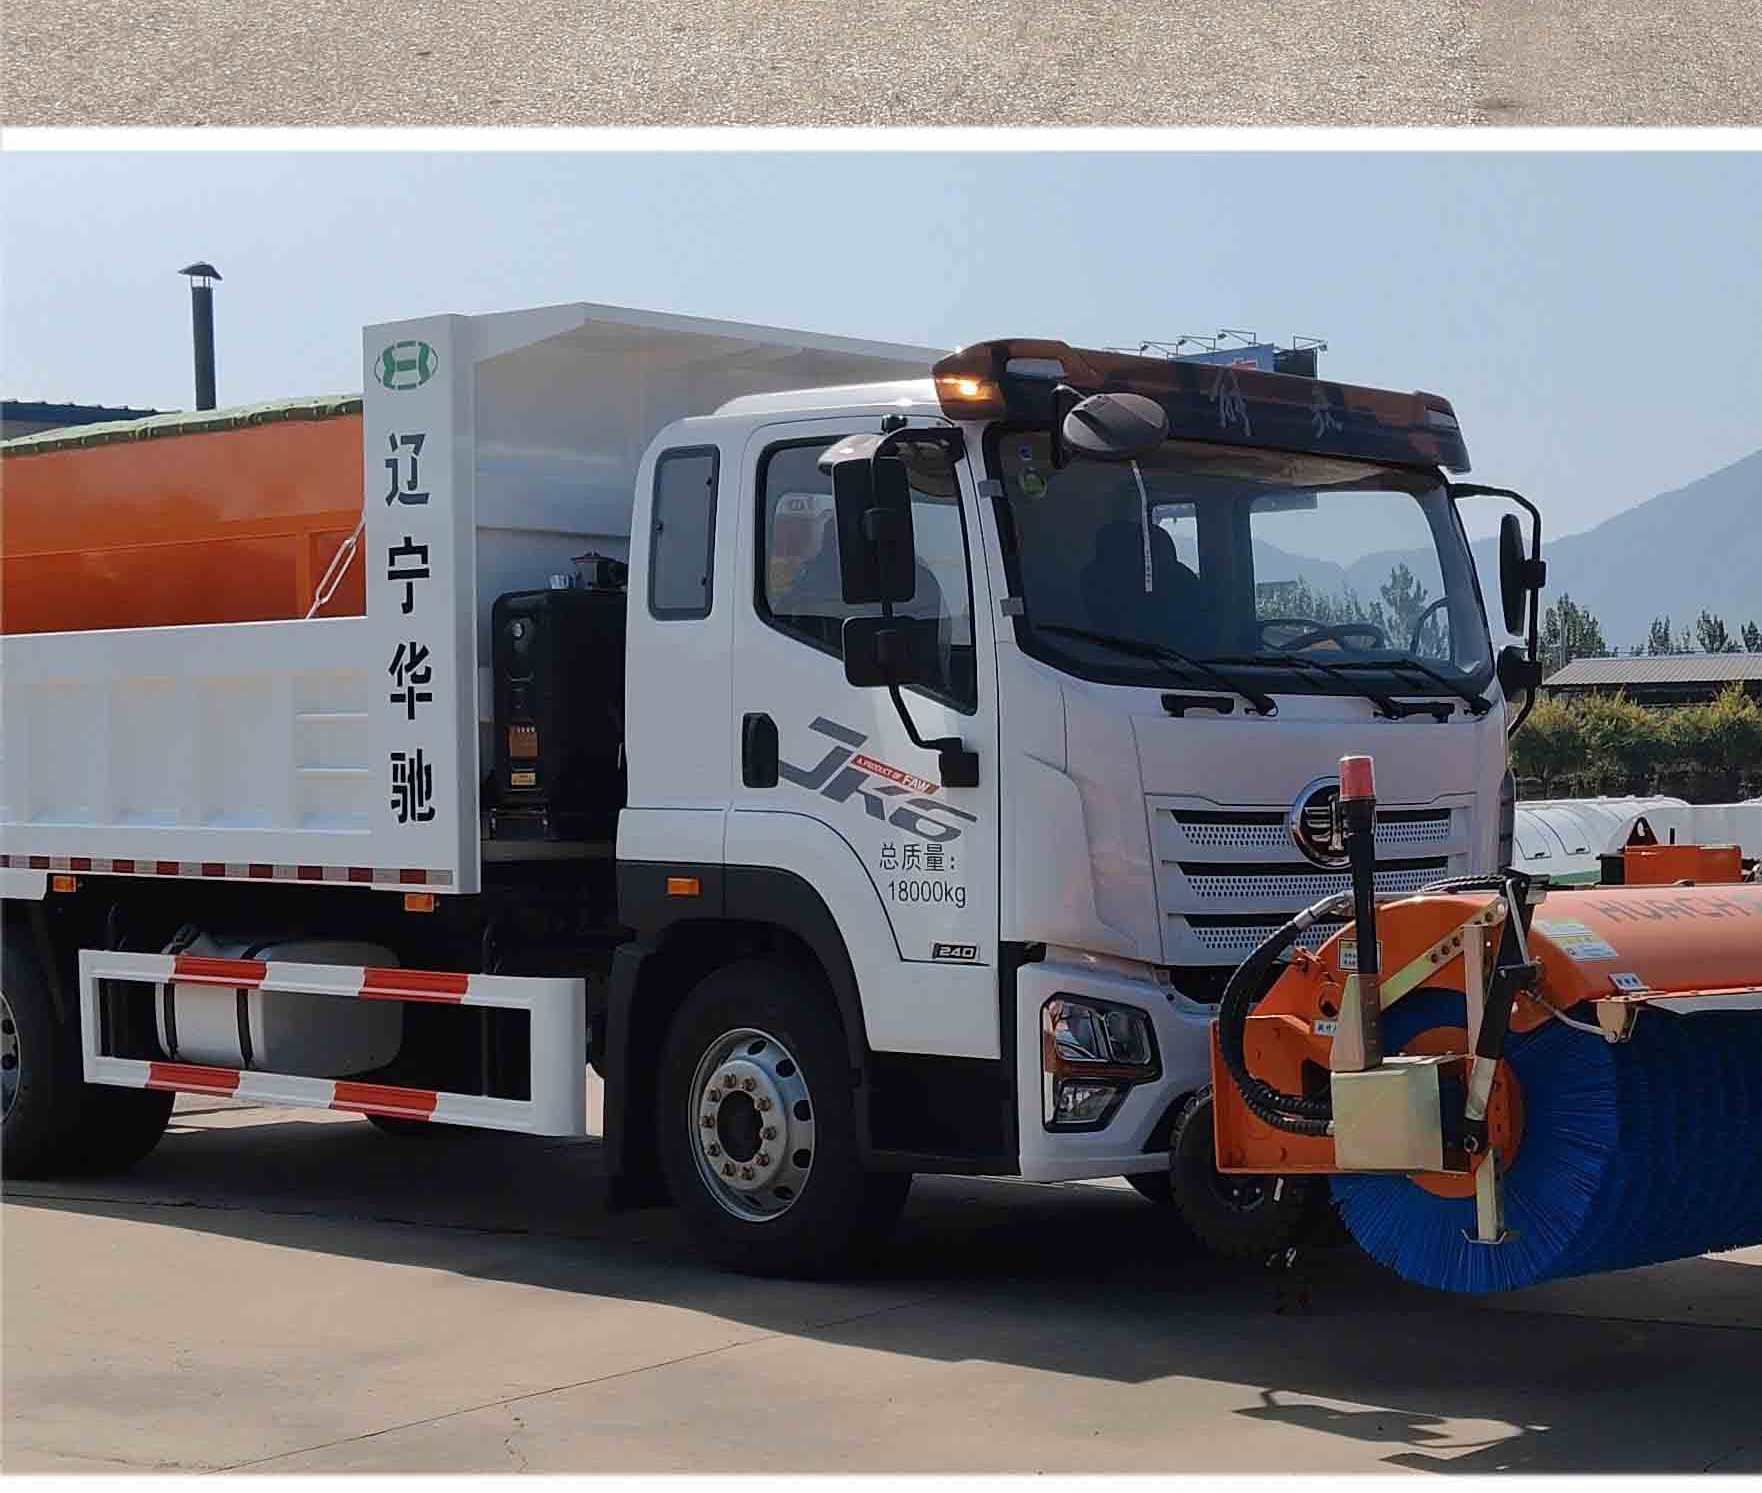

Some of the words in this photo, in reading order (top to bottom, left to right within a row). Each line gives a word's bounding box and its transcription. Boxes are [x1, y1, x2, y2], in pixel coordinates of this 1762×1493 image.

[385, 431, 435, 824] 辽宁华驰
[902, 774, 931, 793] FAW
[879, 843, 956, 872] 总质量：
[887, 880, 966, 908] 18000kg
[938, 946, 975, 959] 240
